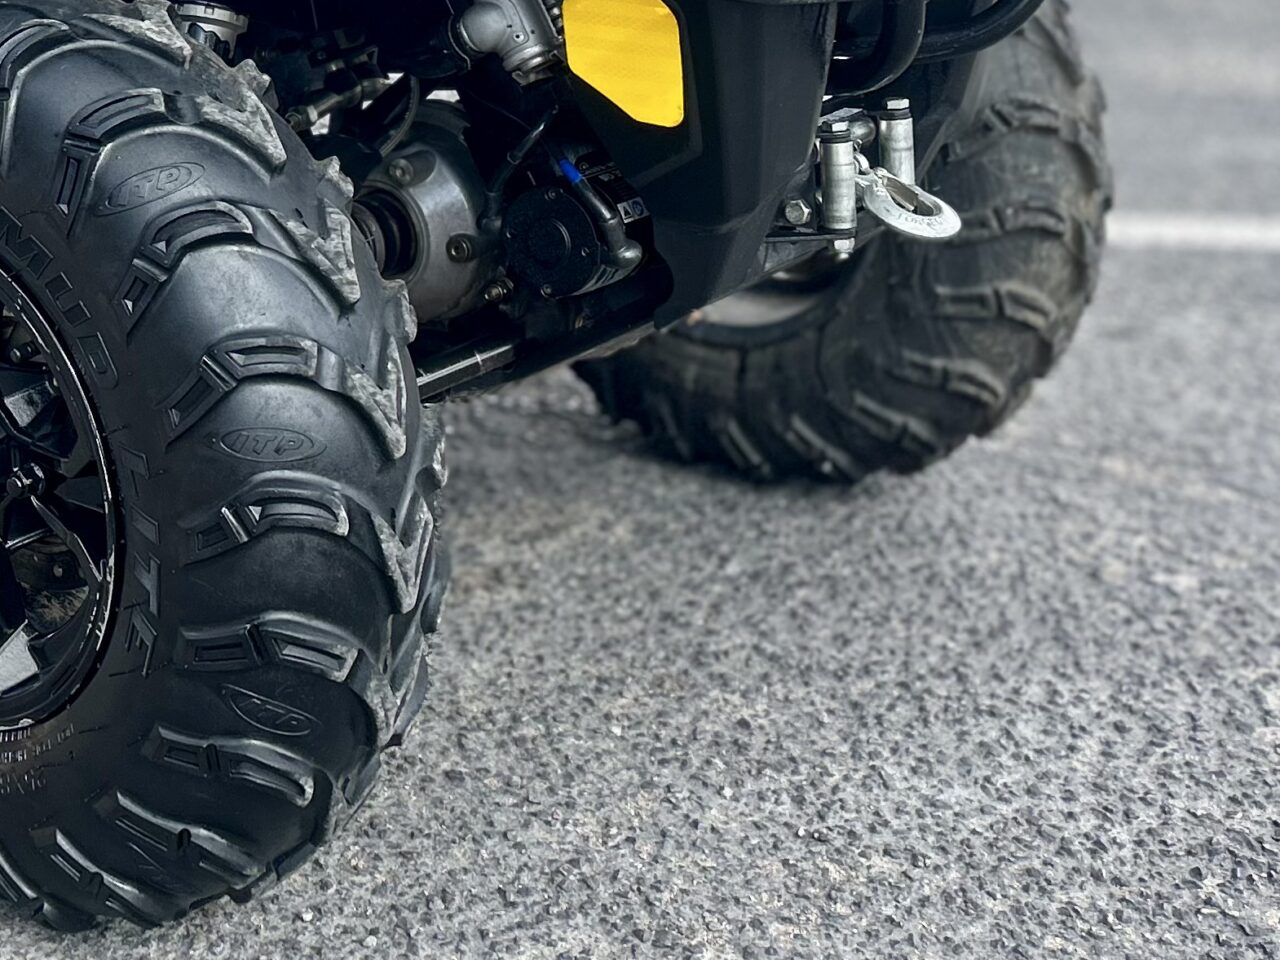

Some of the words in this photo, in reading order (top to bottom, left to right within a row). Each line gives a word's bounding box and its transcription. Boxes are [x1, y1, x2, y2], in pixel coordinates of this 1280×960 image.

[115, 166, 181, 207] ITP
[229, 430, 305, 457] ITP
[119, 442, 161, 677] LITE
